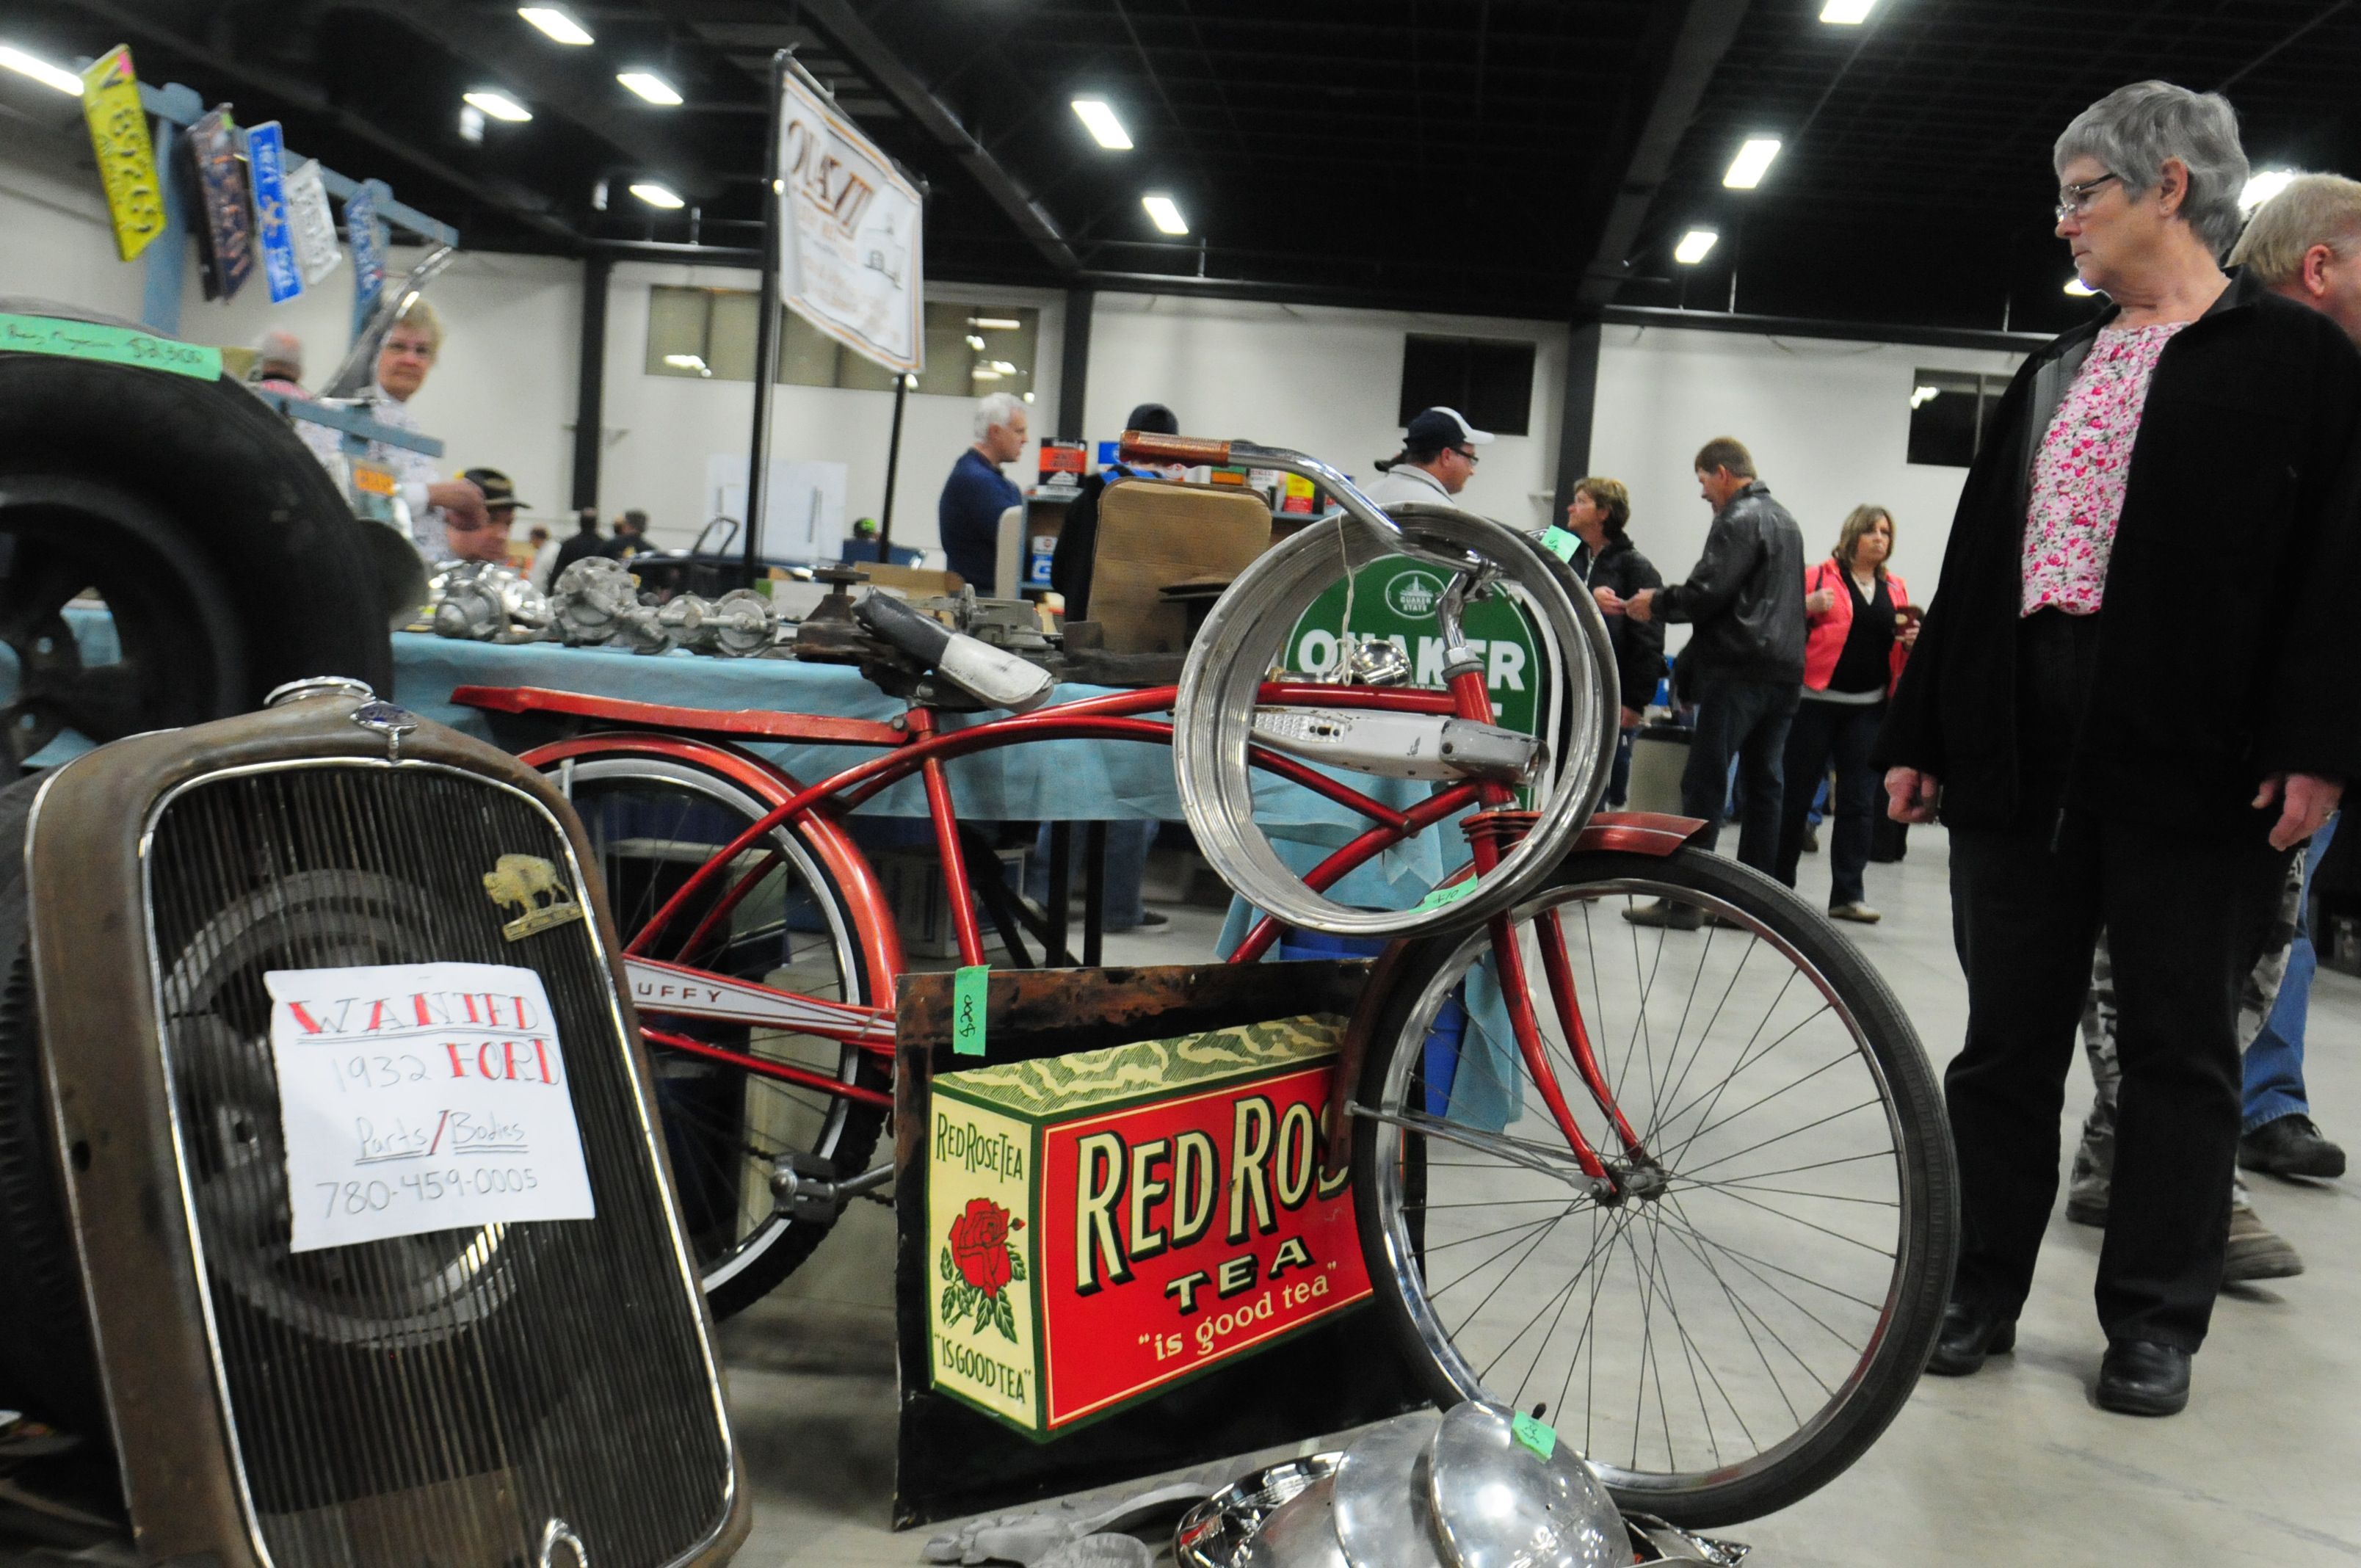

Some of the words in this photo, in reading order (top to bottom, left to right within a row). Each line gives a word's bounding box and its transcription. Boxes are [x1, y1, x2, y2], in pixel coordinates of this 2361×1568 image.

[1298, 629, 1526, 691] QAKR
[289, 992, 539, 1036] WANTED
[637, 981, 722, 1003] UFFY
[333, 1054, 432, 1092] 1932
[440, 1039, 562, 1086] FORD
[316, 1167, 538, 1219] 780-459-0005
[1075, 1129, 1220, 1297] RED
[1164, 1235, 1316, 1316] TEA
[1196, 1290, 1274, 1355] good
